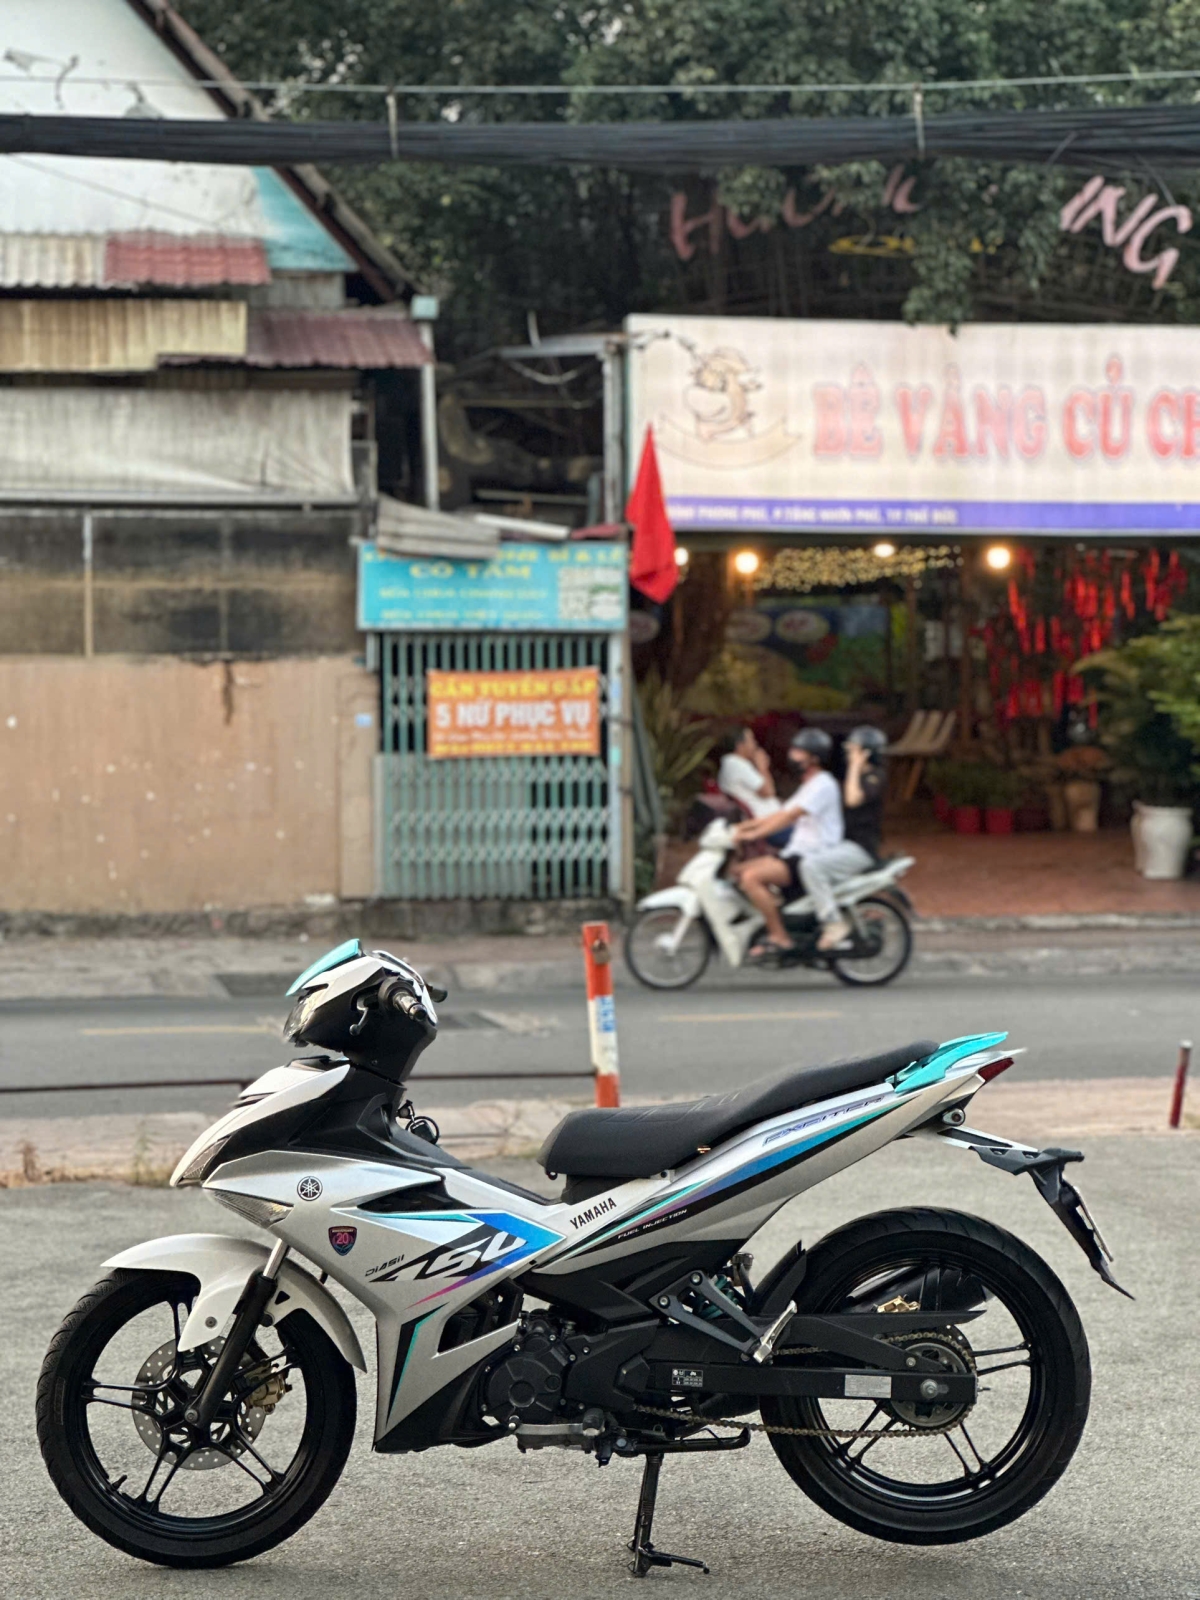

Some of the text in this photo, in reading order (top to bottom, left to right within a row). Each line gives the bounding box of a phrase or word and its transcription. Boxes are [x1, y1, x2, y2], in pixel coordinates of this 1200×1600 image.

[1062, 353, 1135, 459] CỦ
[570, 1198, 617, 1229] YAMAHA
[618, 1209, 688, 1239] FUEL INJECTION
[336, 1232, 349, 1245] 20
